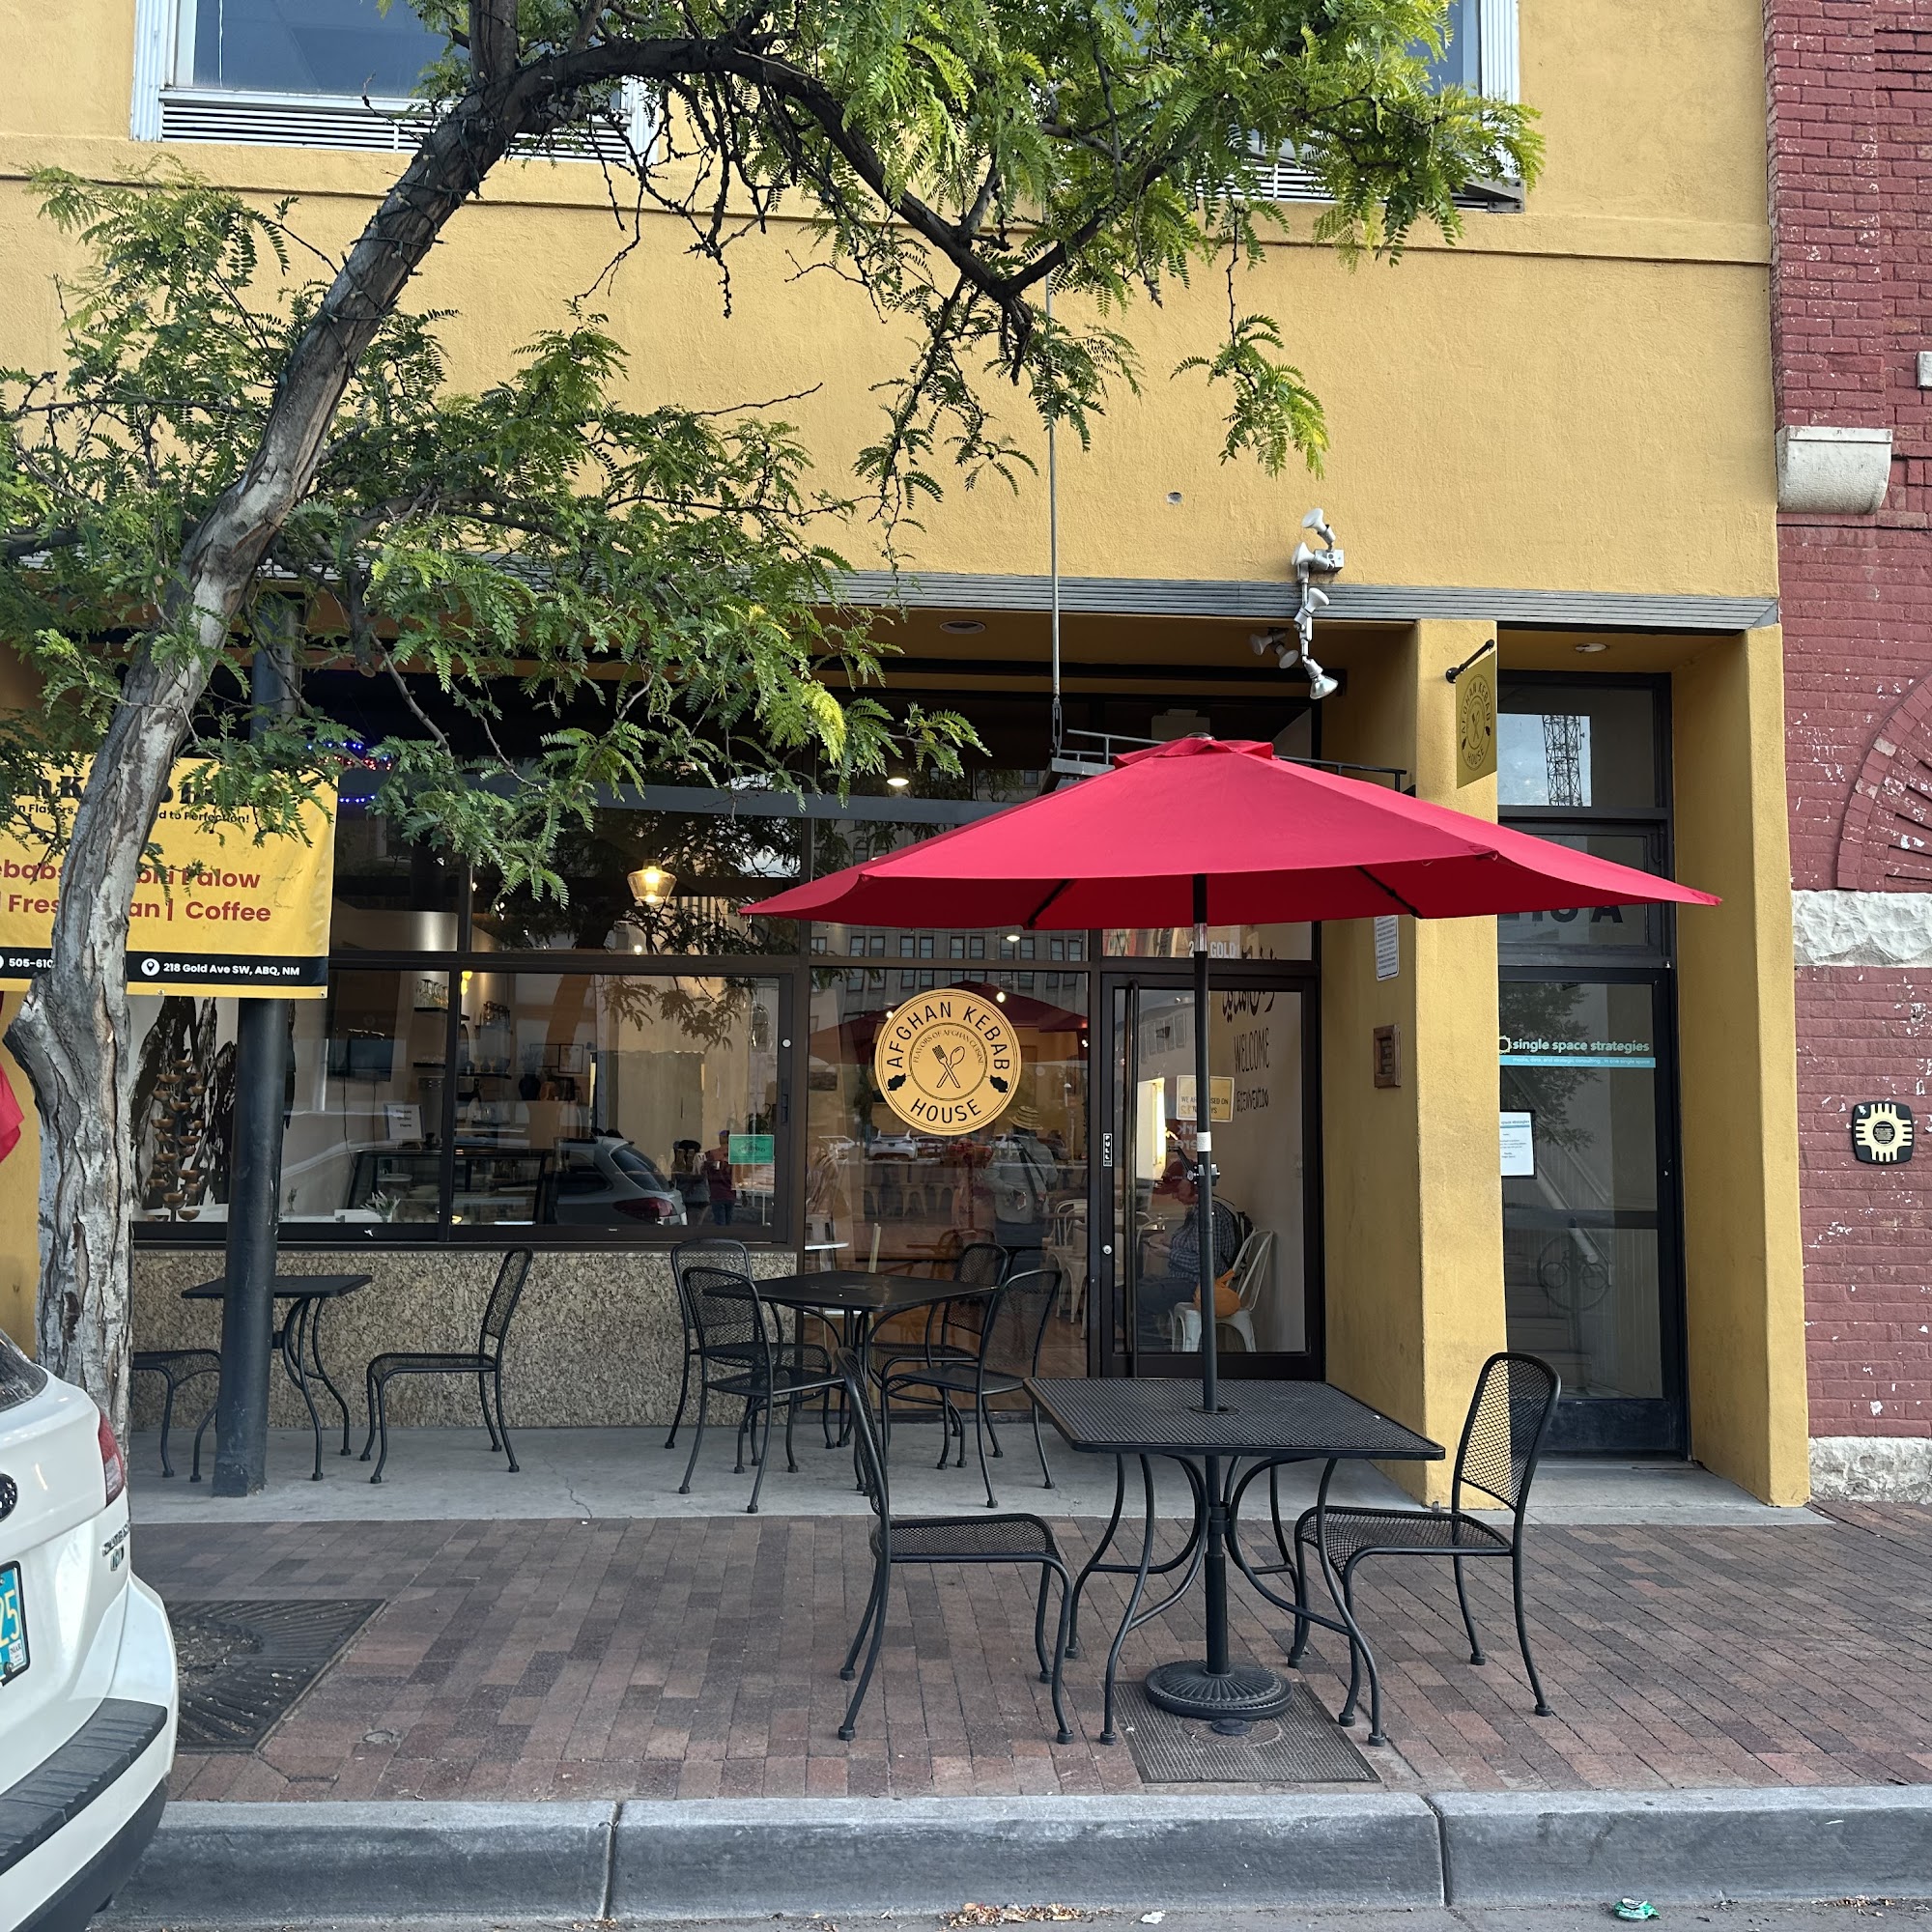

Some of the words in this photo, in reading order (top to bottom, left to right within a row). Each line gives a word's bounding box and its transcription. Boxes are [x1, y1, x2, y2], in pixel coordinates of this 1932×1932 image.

[169, 811, 181, 820] to
[0, 860, 62, 880] bab
[9, 895, 60, 914] Fres
[128, 902, 160, 918] an
[185, 901, 271, 922] Coffee
[1210, 942, 1236, 958] GOLD
[163, 963, 181, 973] 218
[183, 964, 208, 974] Gold
[210, 965, 231, 974] Ave
[232, 965, 253, 976] SW,
[255, 966, 280, 977] ABQ,
[282, 967, 300, 976] NM
[887, 1002, 952, 1069] AFGHAN
[963, 1006, 1010, 1070] KEBAB
[1513, 1038, 1549, 1052] single
[1552, 1041, 1588, 1053] space
[1591, 1040, 1650, 1054] strategies
[913, 1035, 932, 1064] FLAVORS
[943, 1029, 970, 1042] AFGHAN
[1234, 1027, 1270, 1073] WELCOME
[910, 1097, 981, 1123] HOUSE
